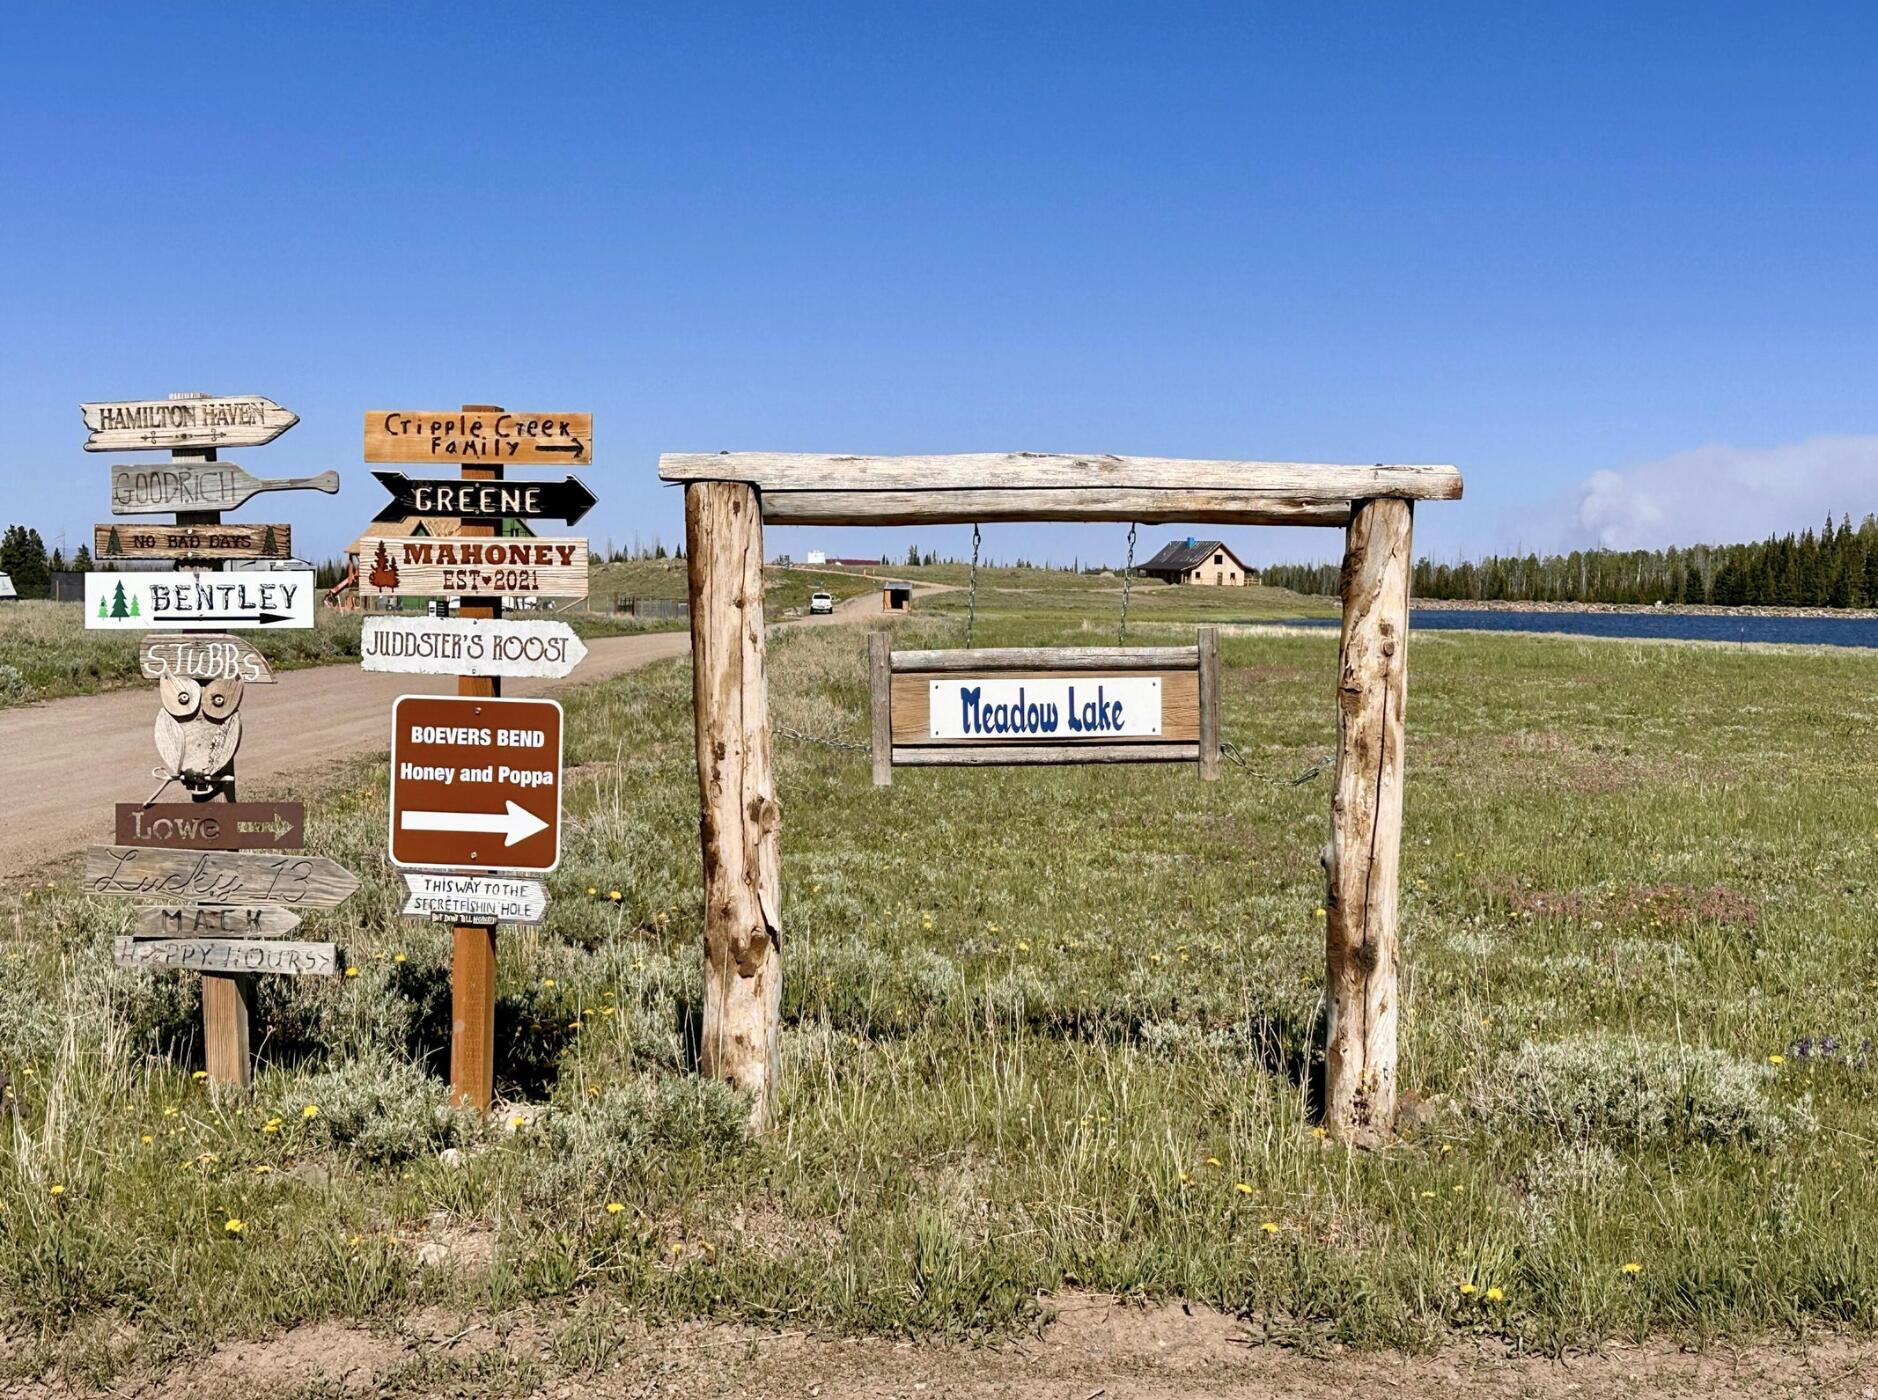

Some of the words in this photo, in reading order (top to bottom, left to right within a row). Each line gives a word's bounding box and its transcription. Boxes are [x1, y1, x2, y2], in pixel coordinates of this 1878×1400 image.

[100, 405, 197, 431] HAMILTON
[202, 402, 265, 427] HAVEN
[385, 413, 483, 438] Cripple
[495, 415, 571, 438] Creek
[115, 471, 235, 505] GOODRICH
[414, 487, 542, 513] GREENE
[134, 535, 156, 549] NO
[168, 535, 200, 548] BAD
[209, 535, 252, 549] DAYS
[403, 543, 576, 566] MAHONEY
[443, 569, 481, 590] EST
[493, 569, 540, 591] 2021
[149, 583, 298, 612] BENTLEY
[366, 630, 484, 660] JUDDSTER'S
[493, 635, 569, 663] ROOST
[960, 686, 1058, 734] Meadow
[1068, 685, 1126, 733] Lake
[411, 726, 491, 746] BOEVERS
[496, 729, 545, 748] BEND
[400, 763, 455, 785] Honey
[459, 765, 493, 783] and
[498, 766, 553, 788] Poppa
[131, 811, 221, 840] Lowe
[95, 848, 243, 902] Lucky
[249, 859, 313, 902] 13
[425, 877, 455, 893] THIS
[456, 879, 482, 894] WAY
[485, 883, 500, 895] TO
[503, 884, 529, 898] THE
[415, 897, 460, 912] SECRET
[501, 902, 532, 917] HOLE
[161, 909, 262, 933] MACK
